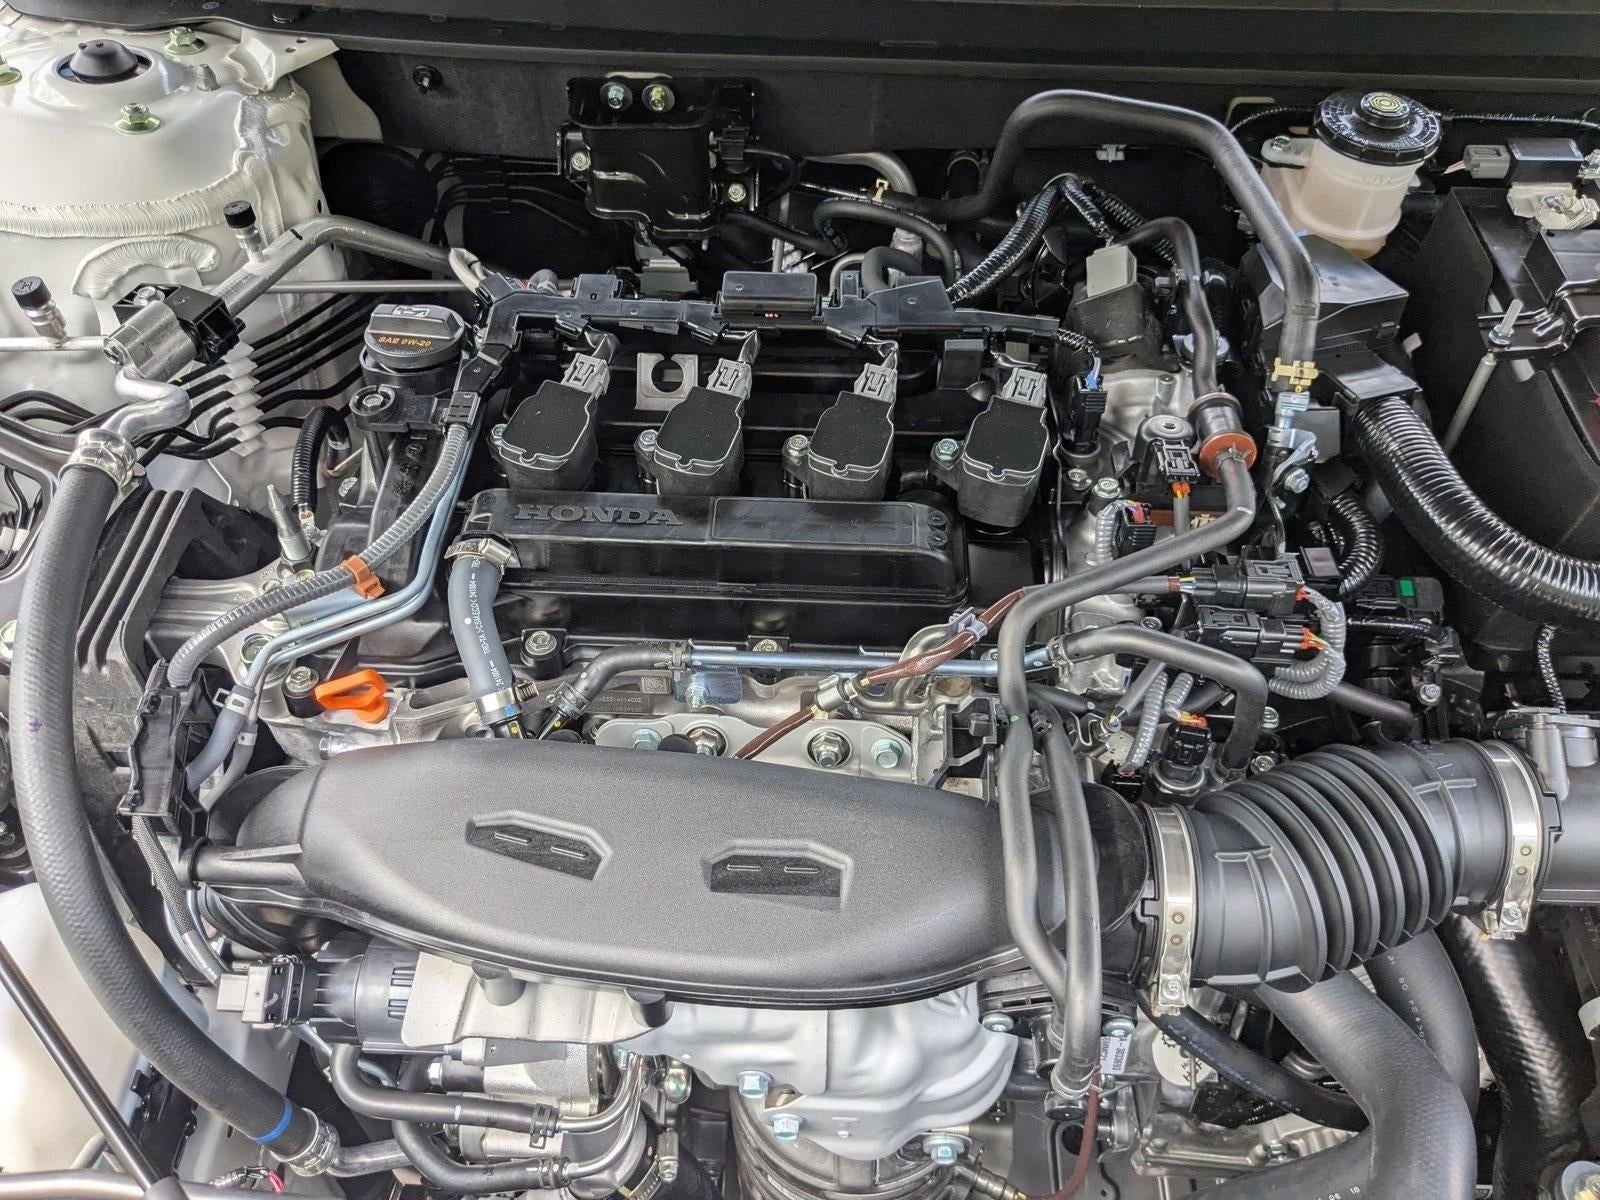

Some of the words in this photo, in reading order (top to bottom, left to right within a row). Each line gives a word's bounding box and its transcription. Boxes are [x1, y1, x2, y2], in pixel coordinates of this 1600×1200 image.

[378, 336, 400, 345] SAE
[401, 338, 432, 347] 0W-20
[514, 503, 684, 526] HONDA
